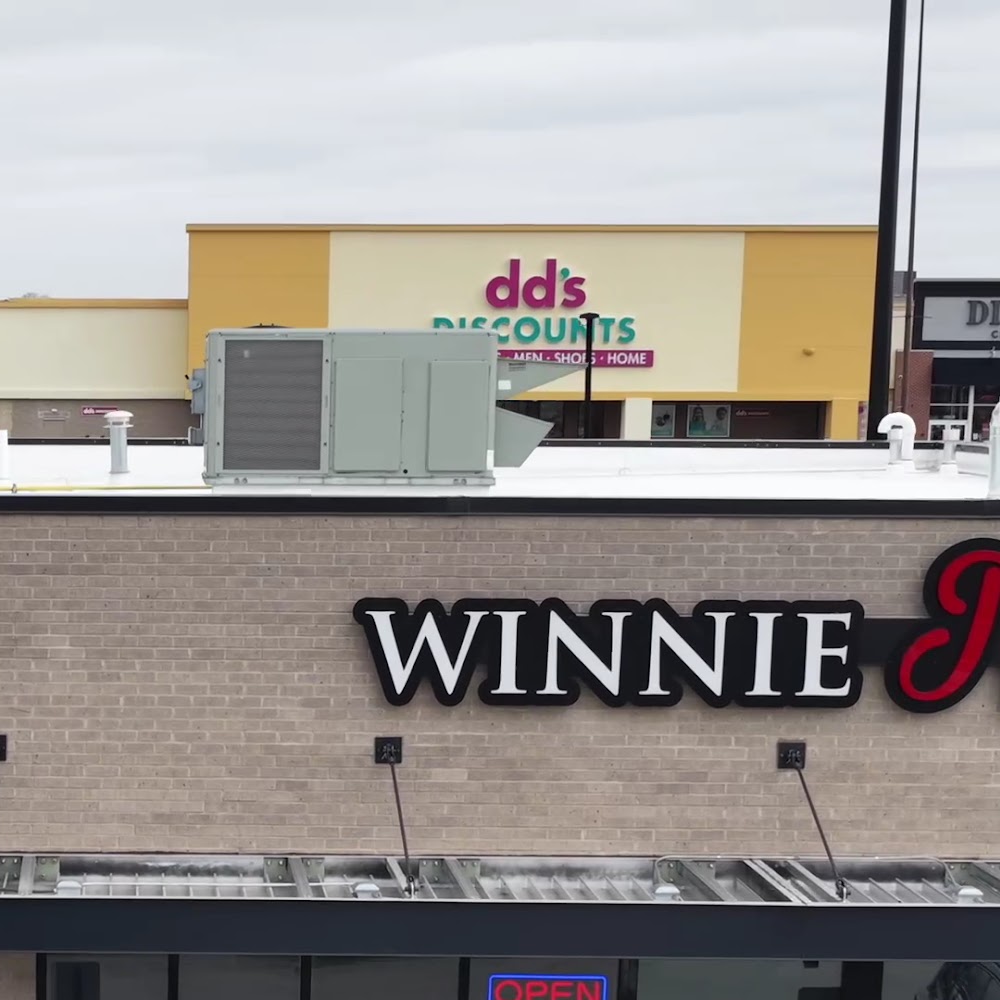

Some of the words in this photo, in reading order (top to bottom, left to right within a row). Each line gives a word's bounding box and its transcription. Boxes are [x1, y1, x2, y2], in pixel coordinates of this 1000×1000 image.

[485, 258, 587, 309] dd's
[513, 352, 543, 363] MEN
[607, 352, 647, 365] HOME
[363, 608, 854, 699] WINNIE
